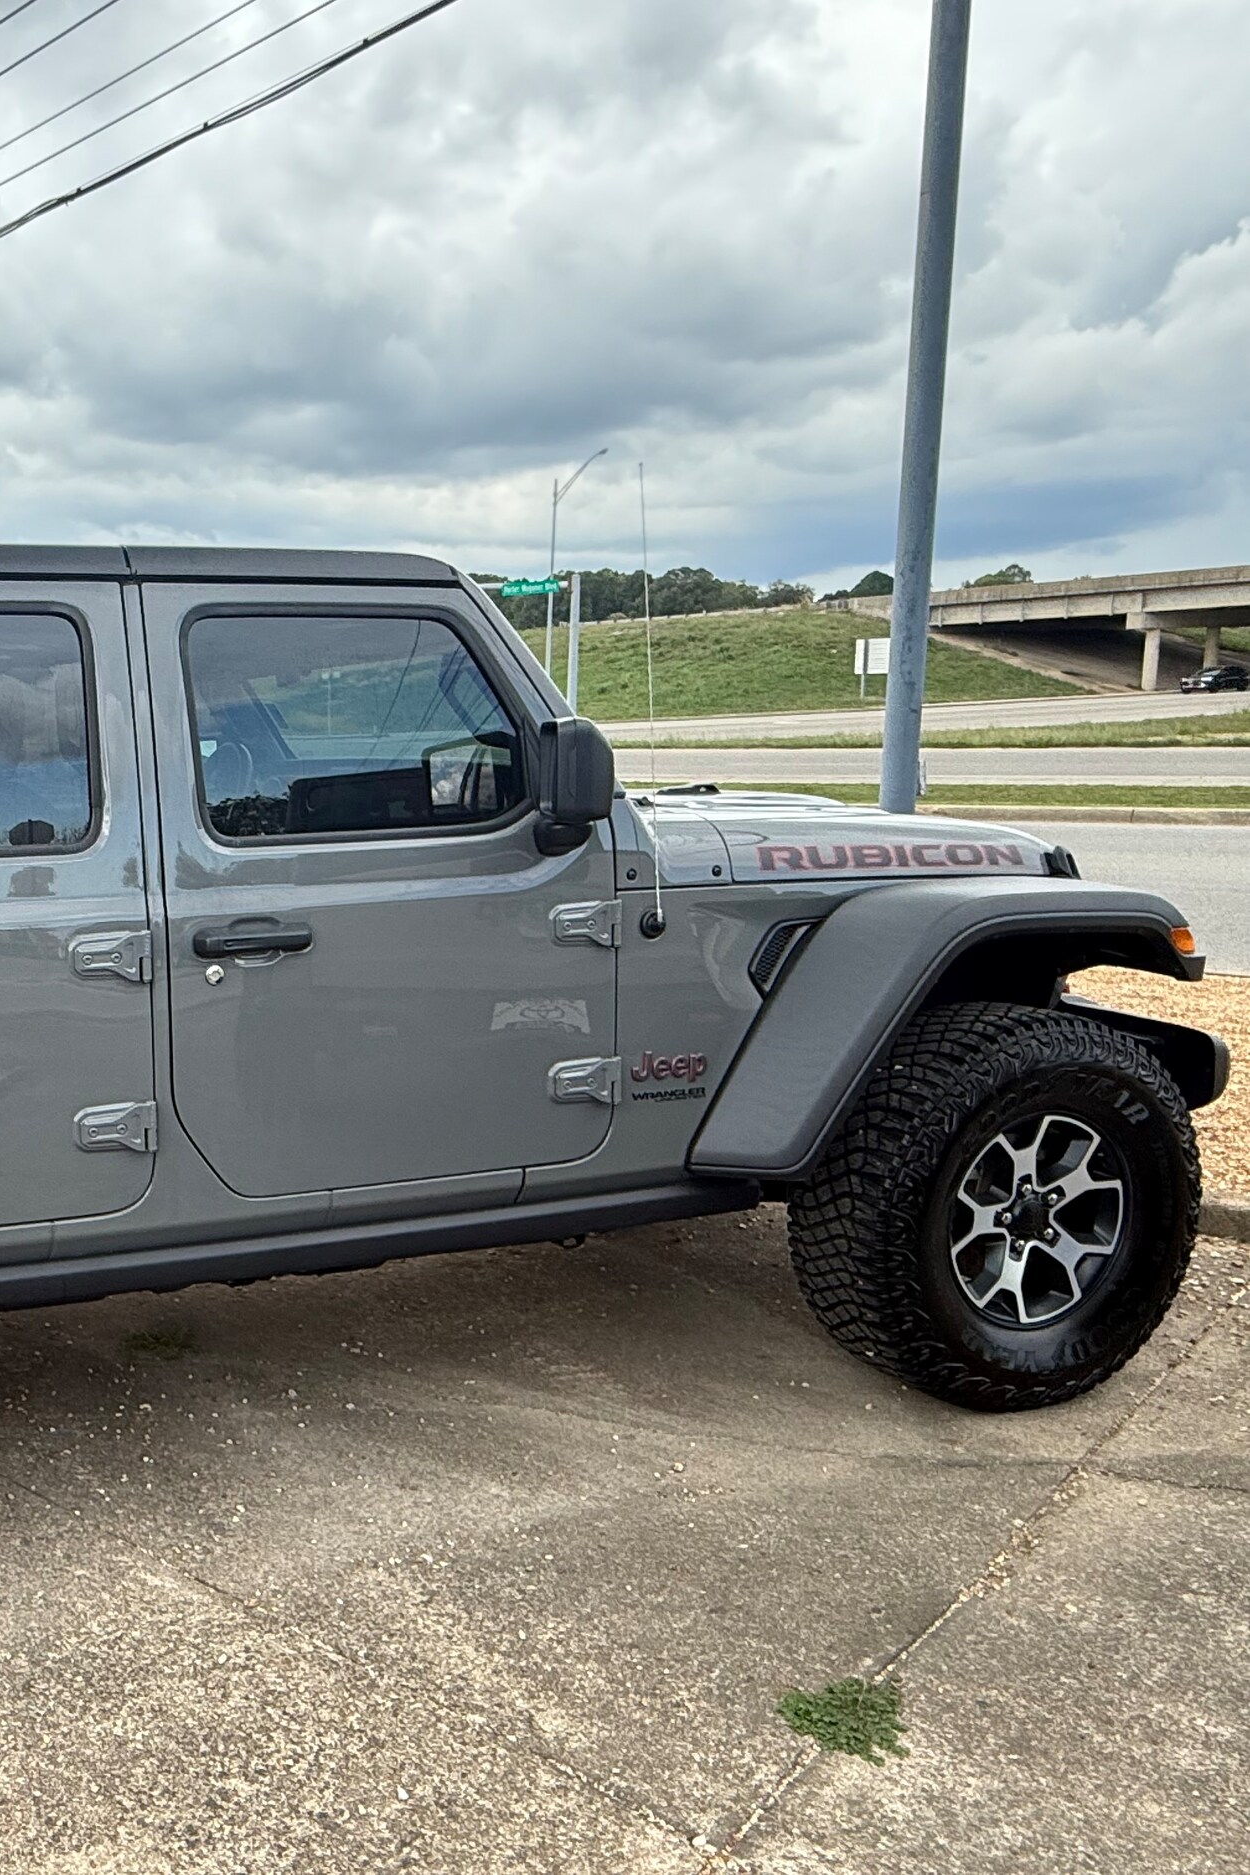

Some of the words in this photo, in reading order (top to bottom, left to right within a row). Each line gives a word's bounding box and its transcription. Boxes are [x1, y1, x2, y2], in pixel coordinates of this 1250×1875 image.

[756, 843, 1025, 871] RUBICON
[631, 1050, 707, 1083] Jeep
[631, 1086, 706, 1101] WRANGLER
